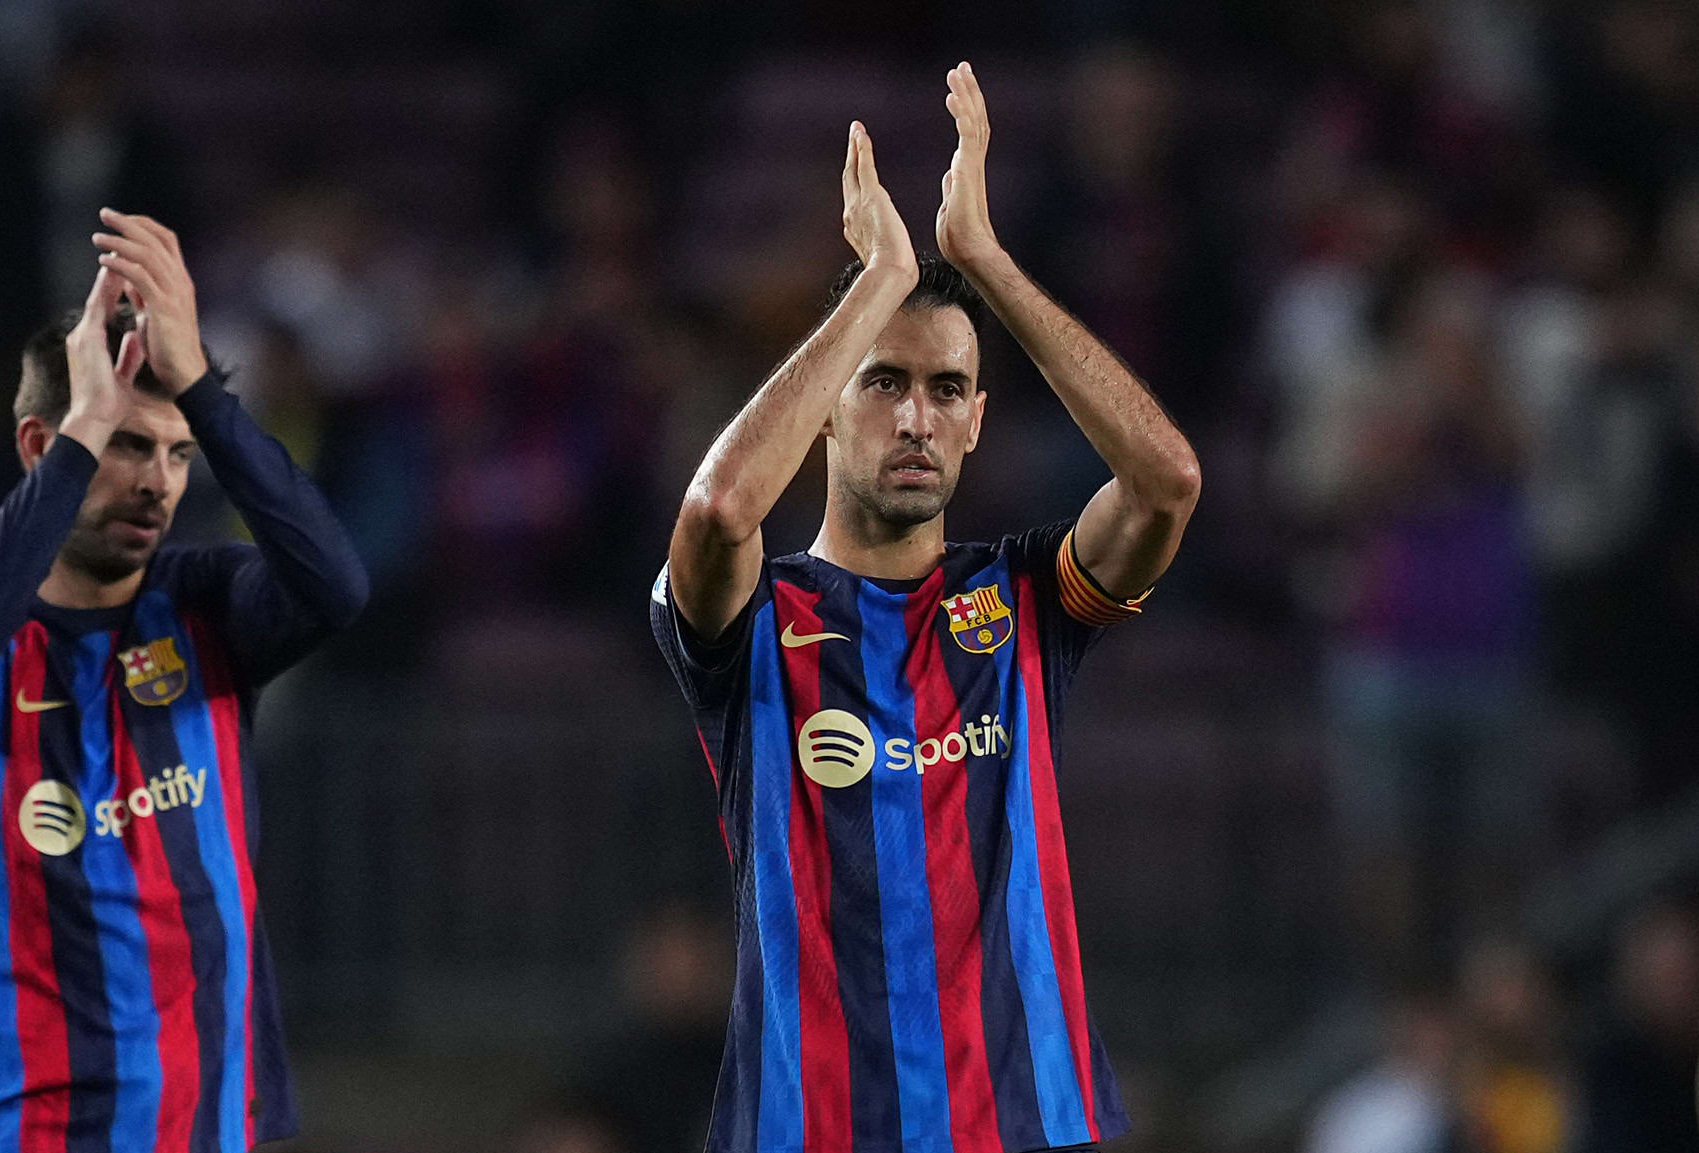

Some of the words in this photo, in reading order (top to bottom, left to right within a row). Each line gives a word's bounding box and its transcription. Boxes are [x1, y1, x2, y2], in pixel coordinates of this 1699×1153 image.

[966, 614, 991, 628] FCB
[884, 714, 1014, 775] Spotify
[95, 765, 206, 838] Spotify
